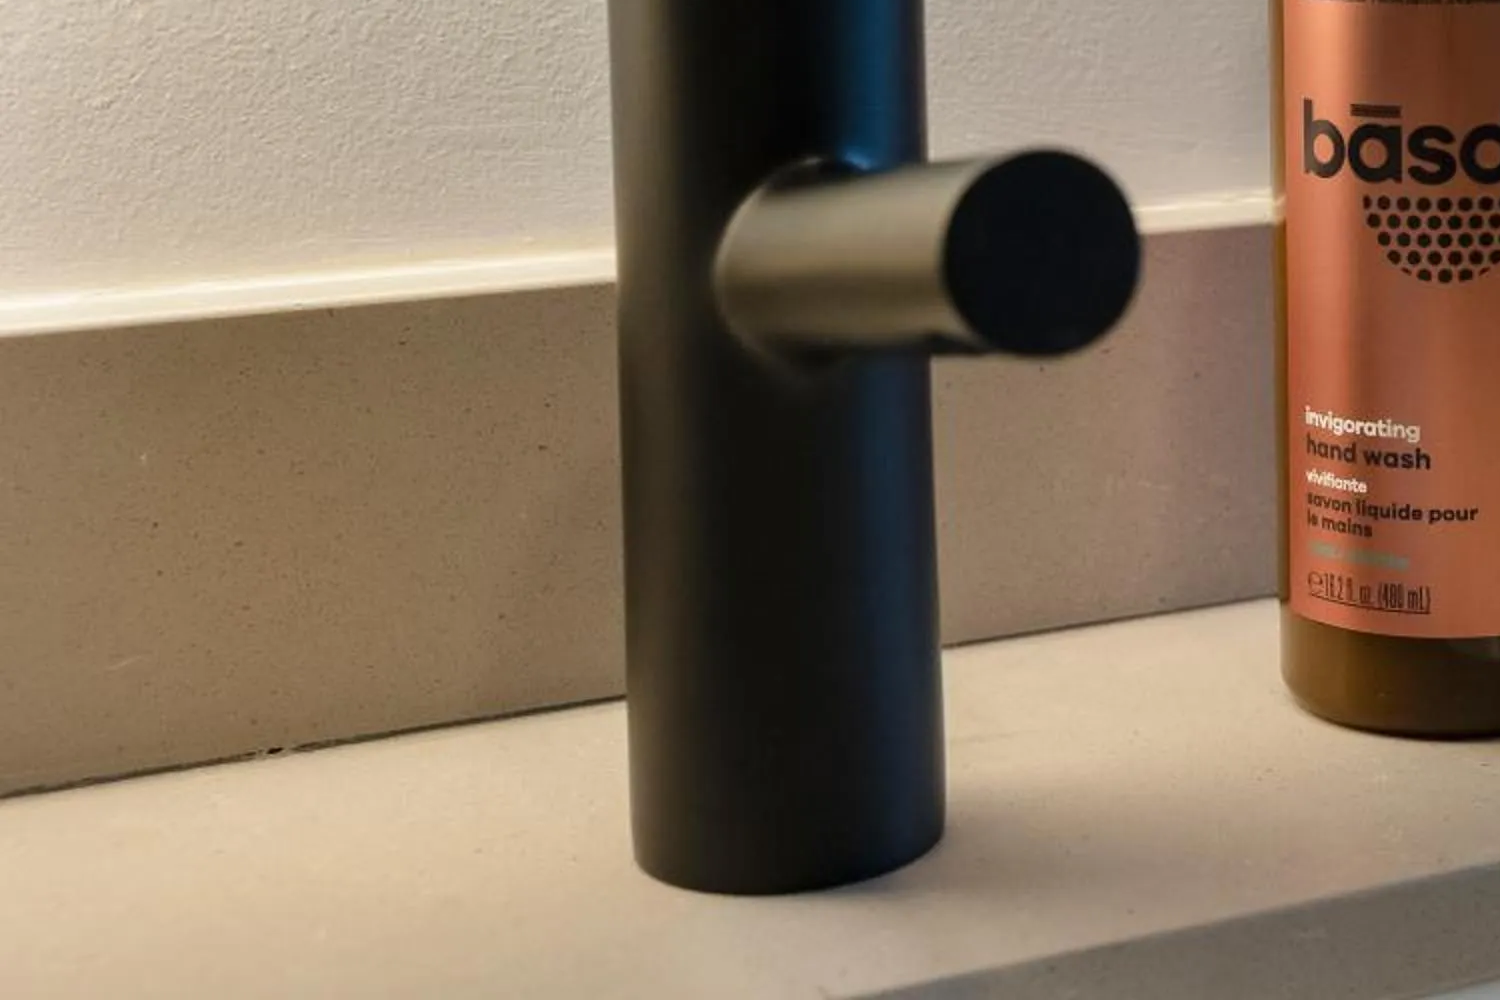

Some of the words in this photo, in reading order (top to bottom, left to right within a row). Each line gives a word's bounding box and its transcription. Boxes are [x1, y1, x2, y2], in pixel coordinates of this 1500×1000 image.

[1304, 406, 1421, 443] invigorating
[1306, 433, 1357, 464] hand
[1363, 448, 1431, 470] wash
[1305, 467, 1367, 494] vivifiante
[1307, 491, 1351, 514] savon
[1356, 496, 1423, 522] liquide
[1429, 506, 1479, 525] pour
[1321, 513, 1373, 538] mains
